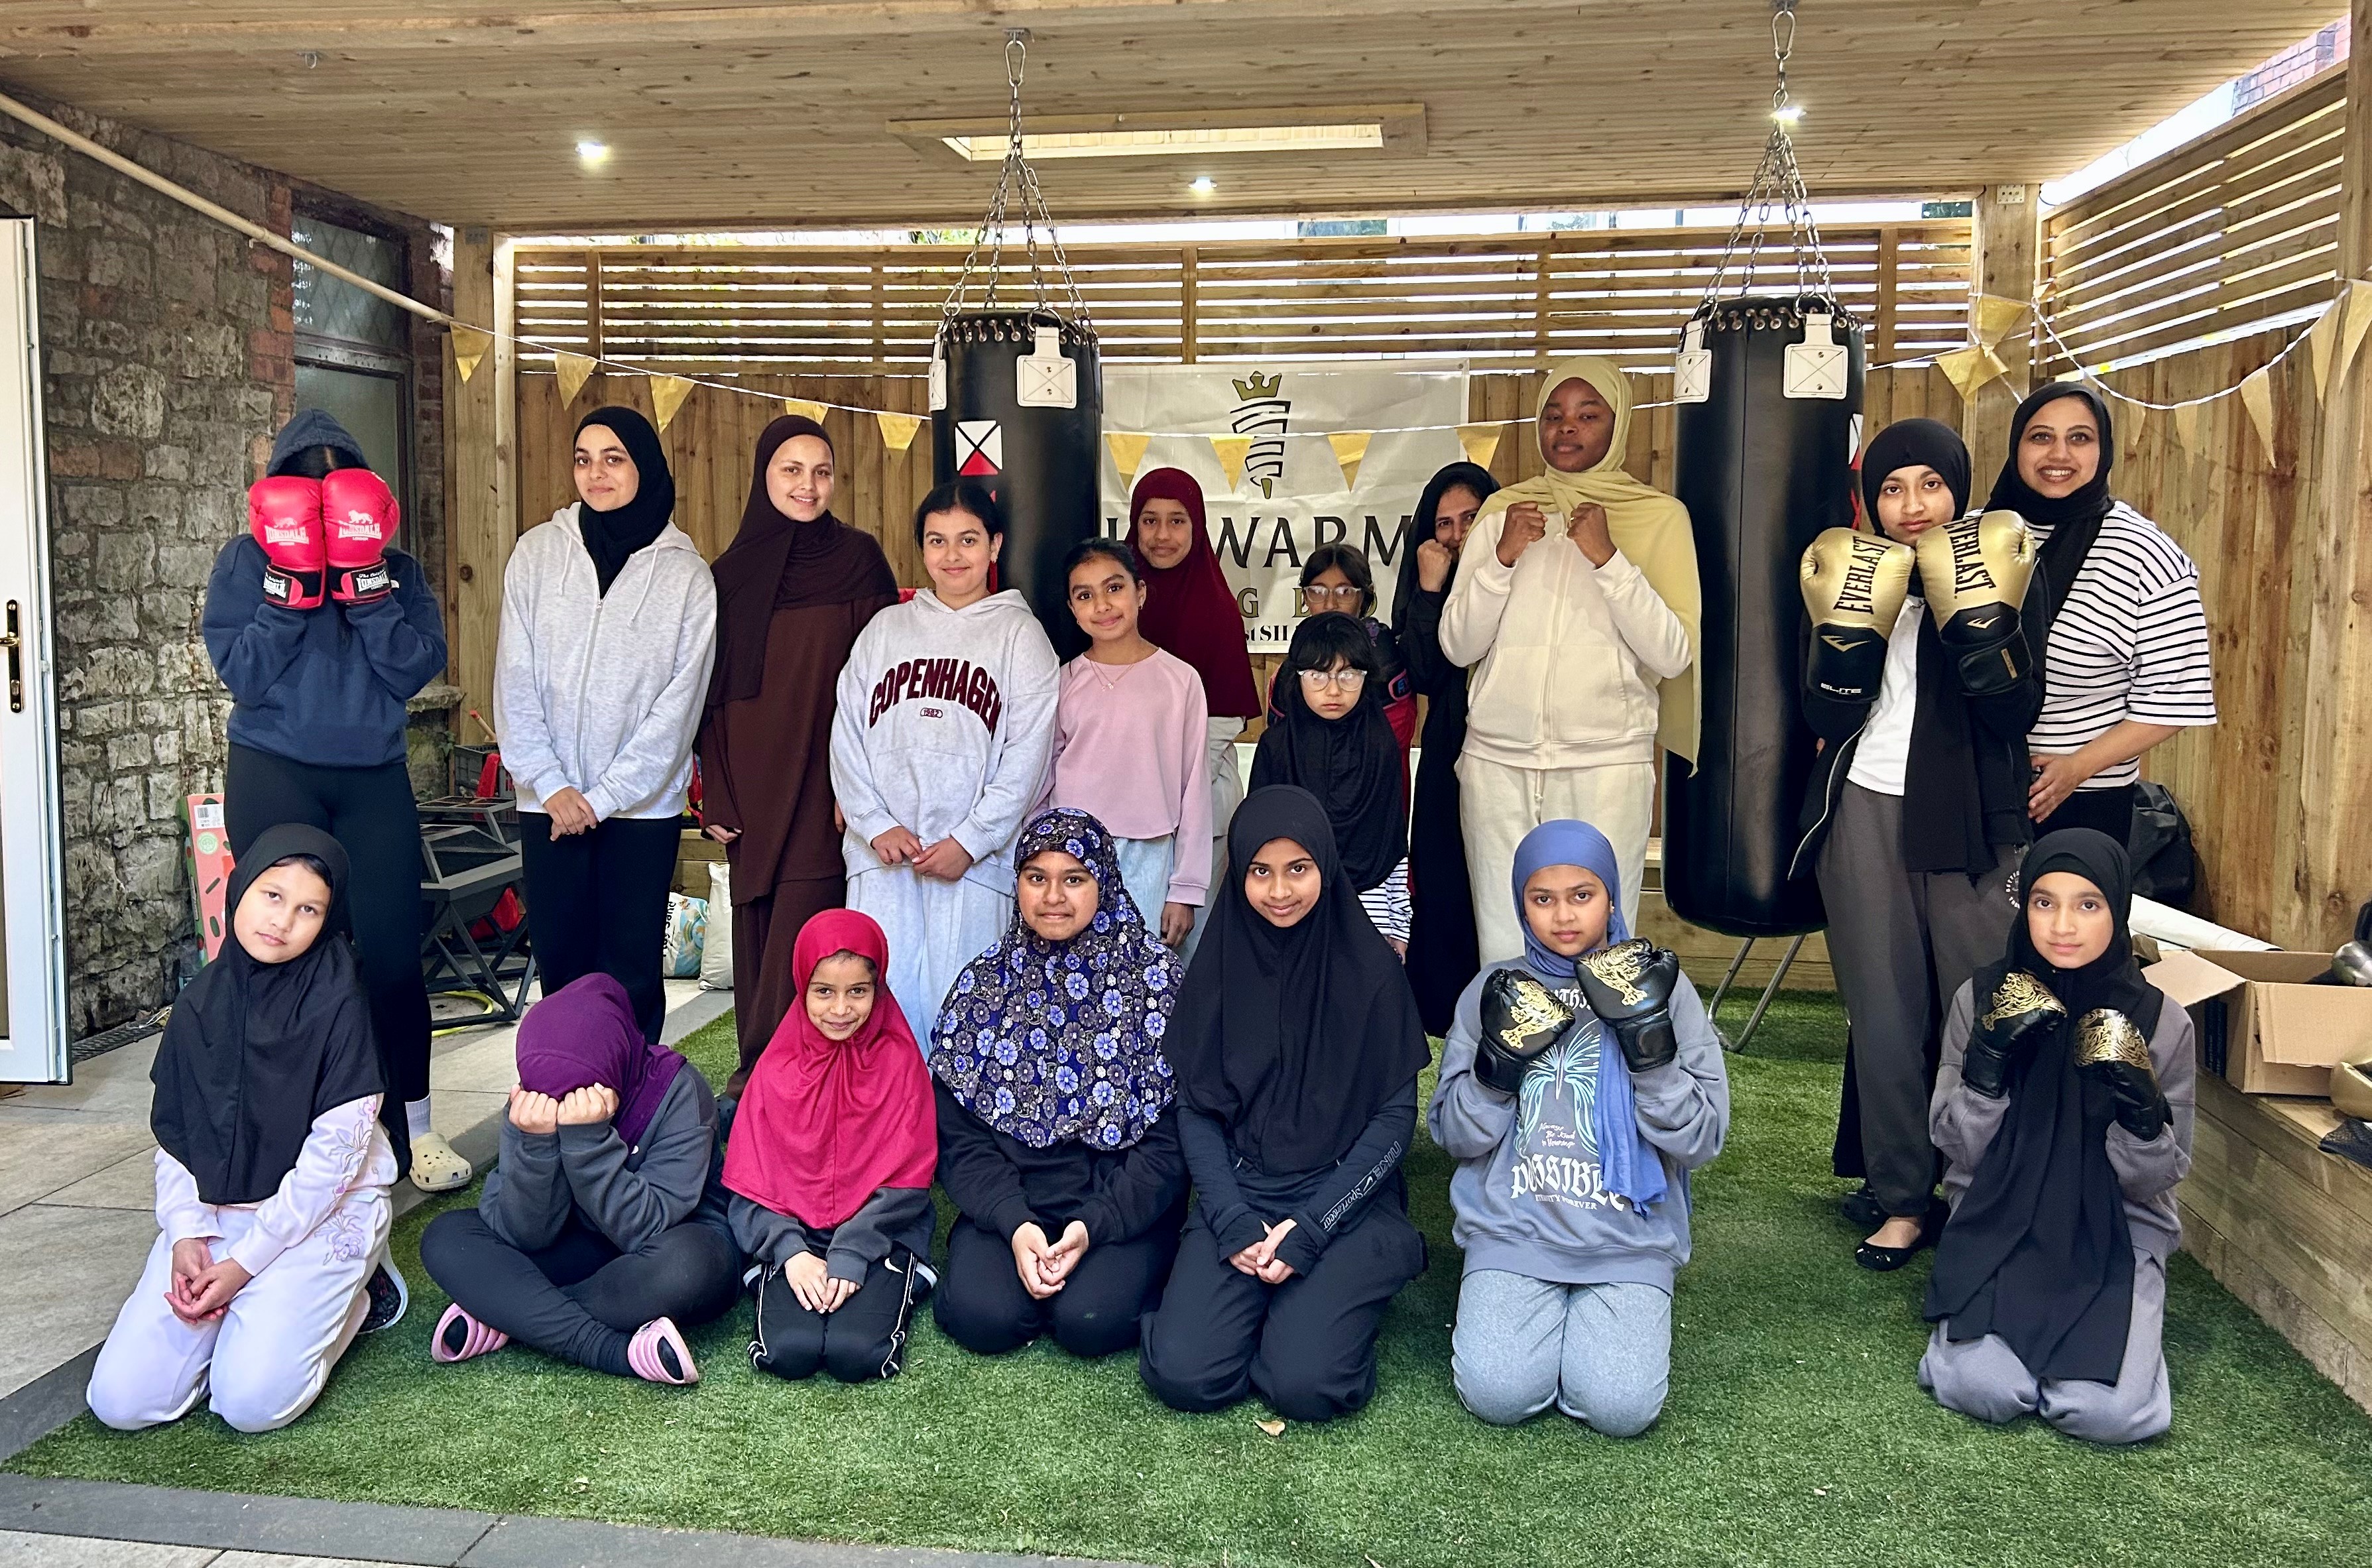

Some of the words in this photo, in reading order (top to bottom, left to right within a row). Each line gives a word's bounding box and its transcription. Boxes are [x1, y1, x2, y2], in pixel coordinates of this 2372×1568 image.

[1833, 536, 1891, 615] EVERLAST
[1942, 515, 1997, 593] EVERLAST
[869, 658, 1002, 743] COPENHAGEN
[1372, 1140, 1402, 1180] NIKE
